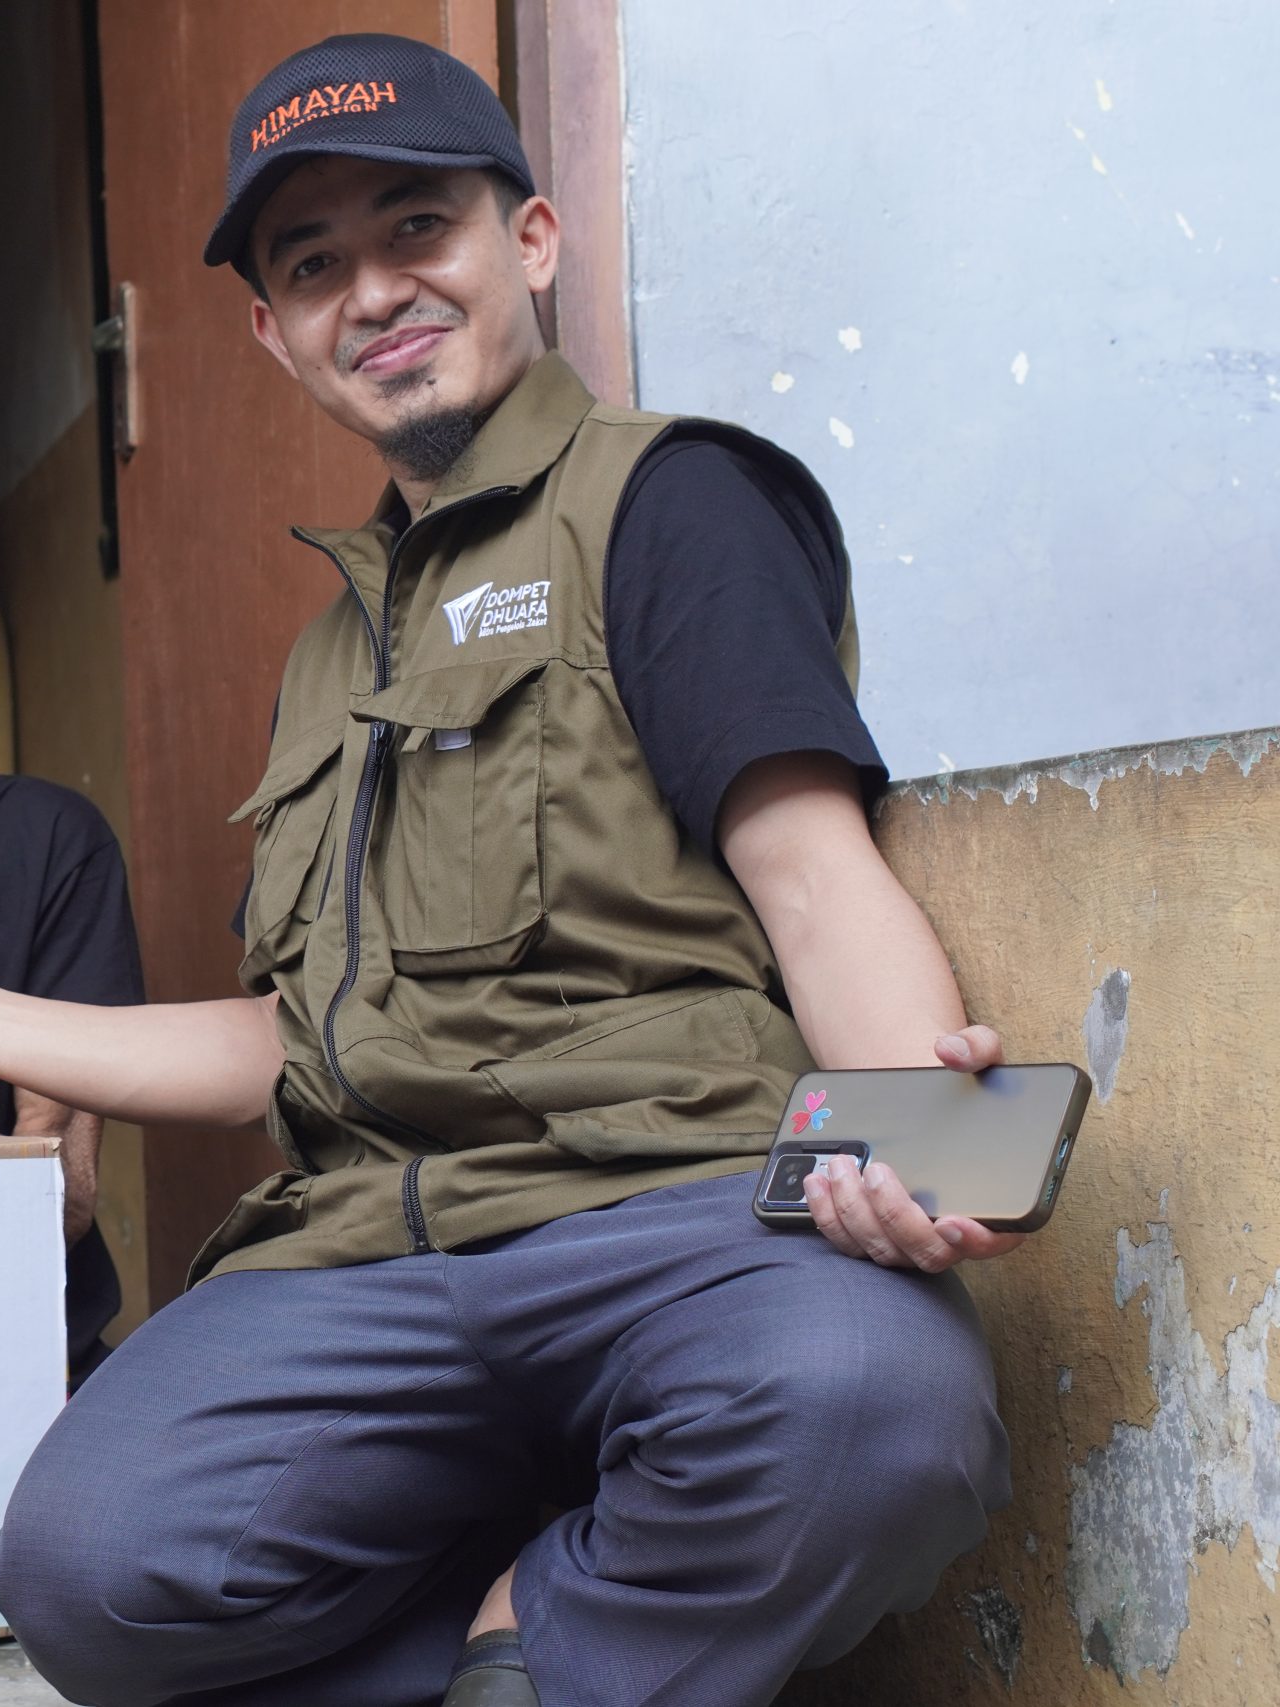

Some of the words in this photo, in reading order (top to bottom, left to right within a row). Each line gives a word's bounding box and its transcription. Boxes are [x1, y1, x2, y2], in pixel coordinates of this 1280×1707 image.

[250, 82, 397, 152] HIMAYAH
[485, 581, 551, 608] DOMPET
[480, 599, 548, 628] DHUAFA
